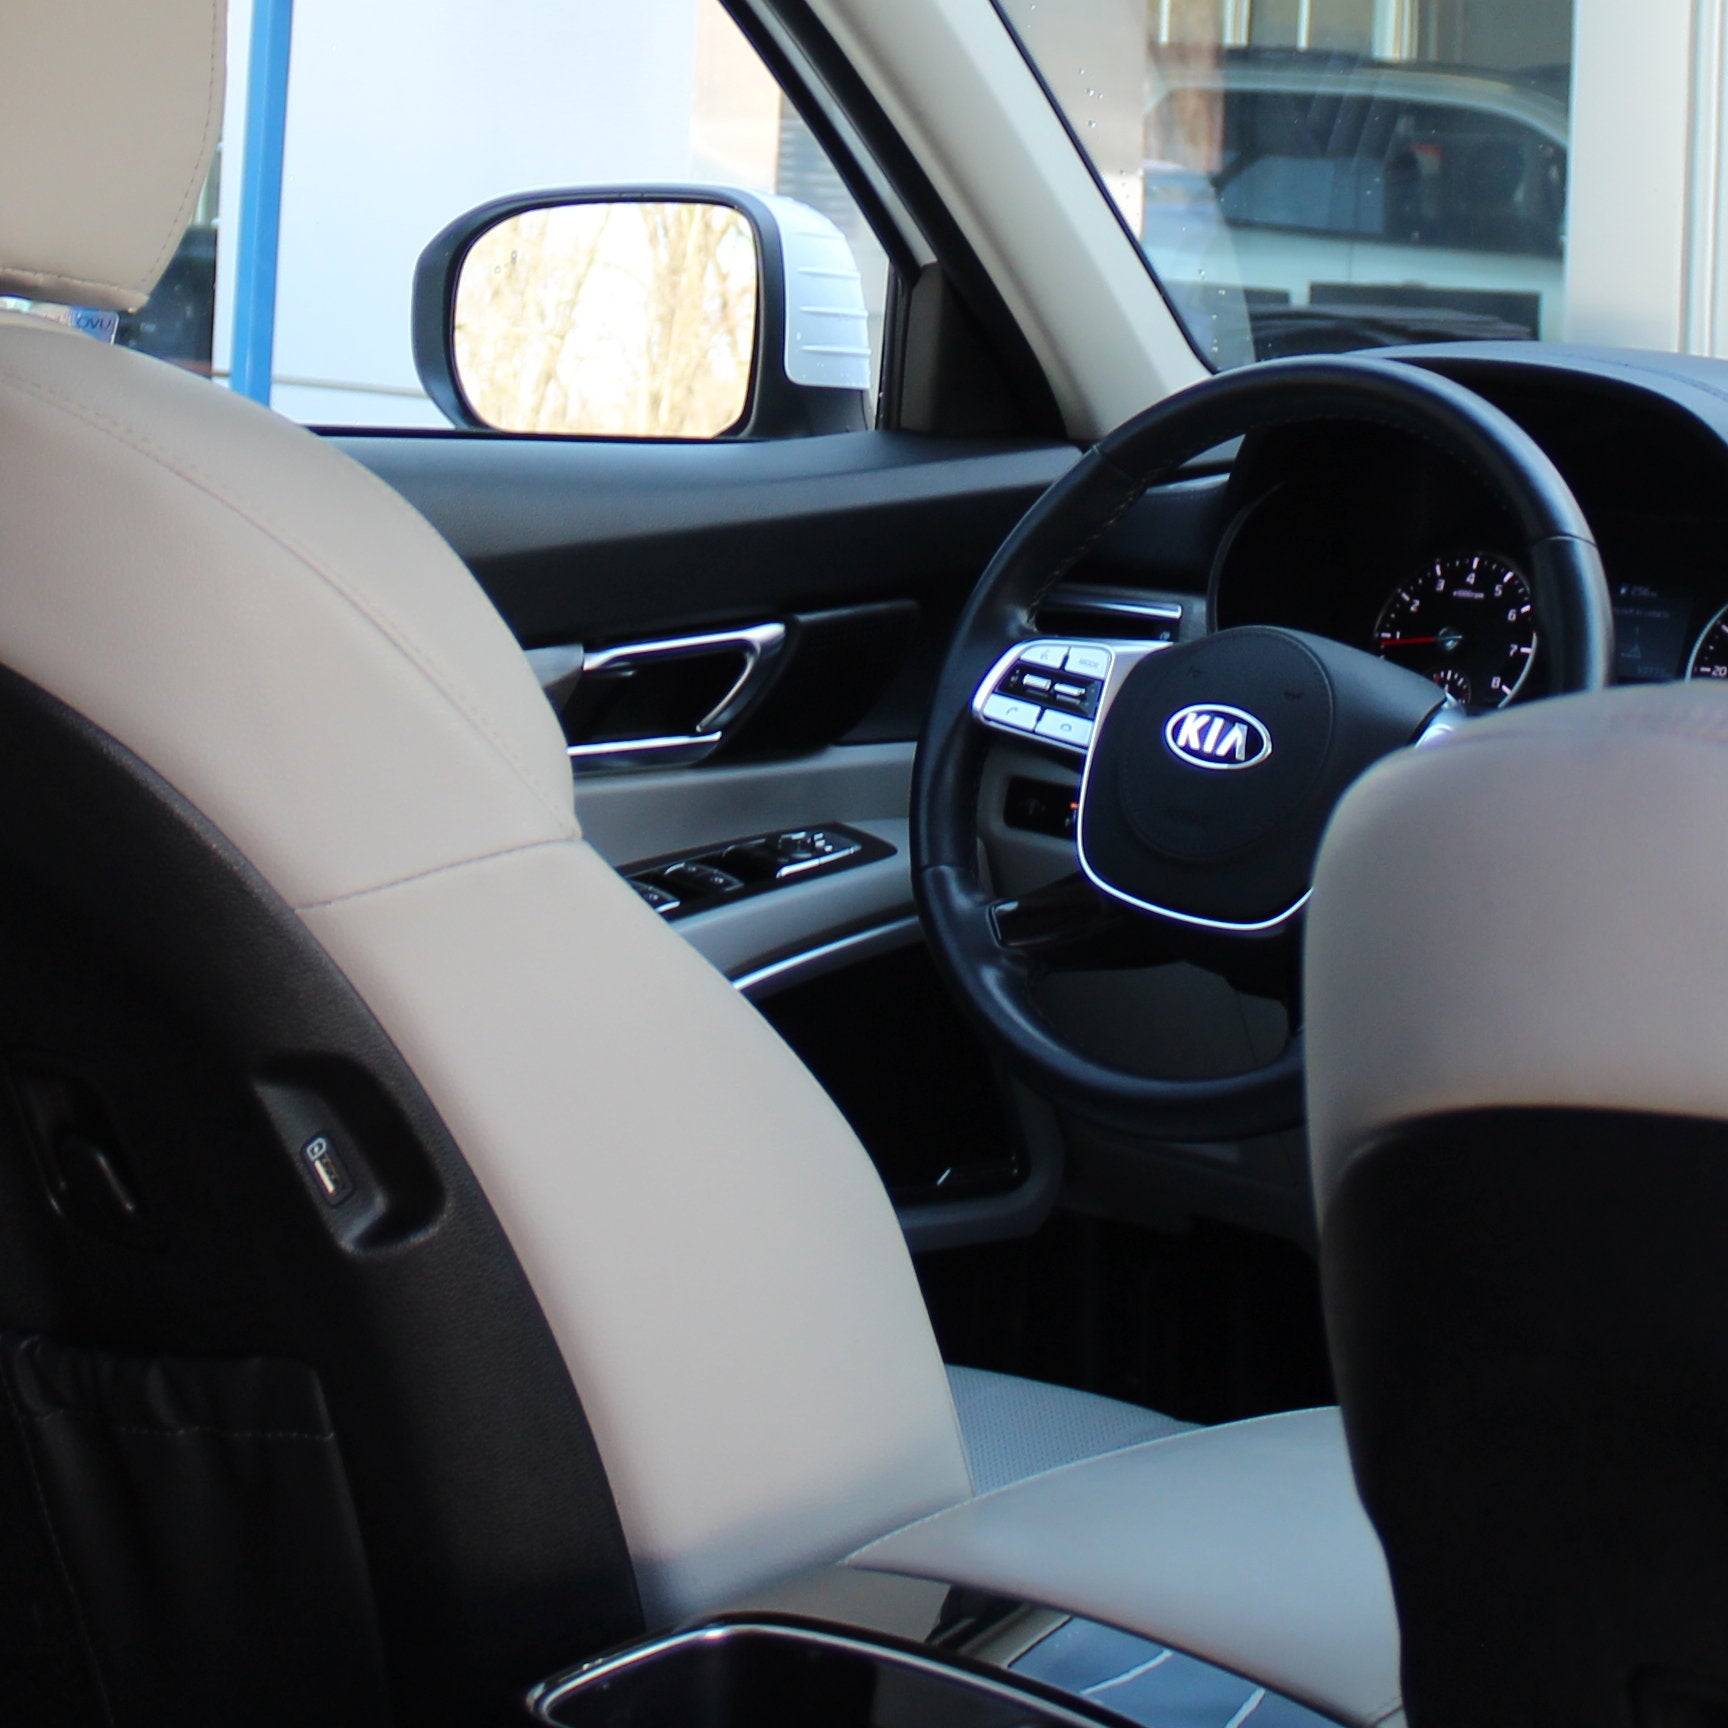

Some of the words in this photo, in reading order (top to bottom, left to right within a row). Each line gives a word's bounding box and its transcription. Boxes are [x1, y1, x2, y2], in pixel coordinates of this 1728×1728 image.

[1436, 579, 1445, 592] 3
[1466, 573, 1475, 585] 4
[1494, 584, 1503, 597] 5
[1410, 599, 1420, 612] 2
[1507, 609, 1516, 621] 6
[1509, 644, 1518, 657] 7
[1712, 665, 1727, 677] 20
[1491, 676, 1501, 689] 8
[1177, 712, 1248, 761] KIA
